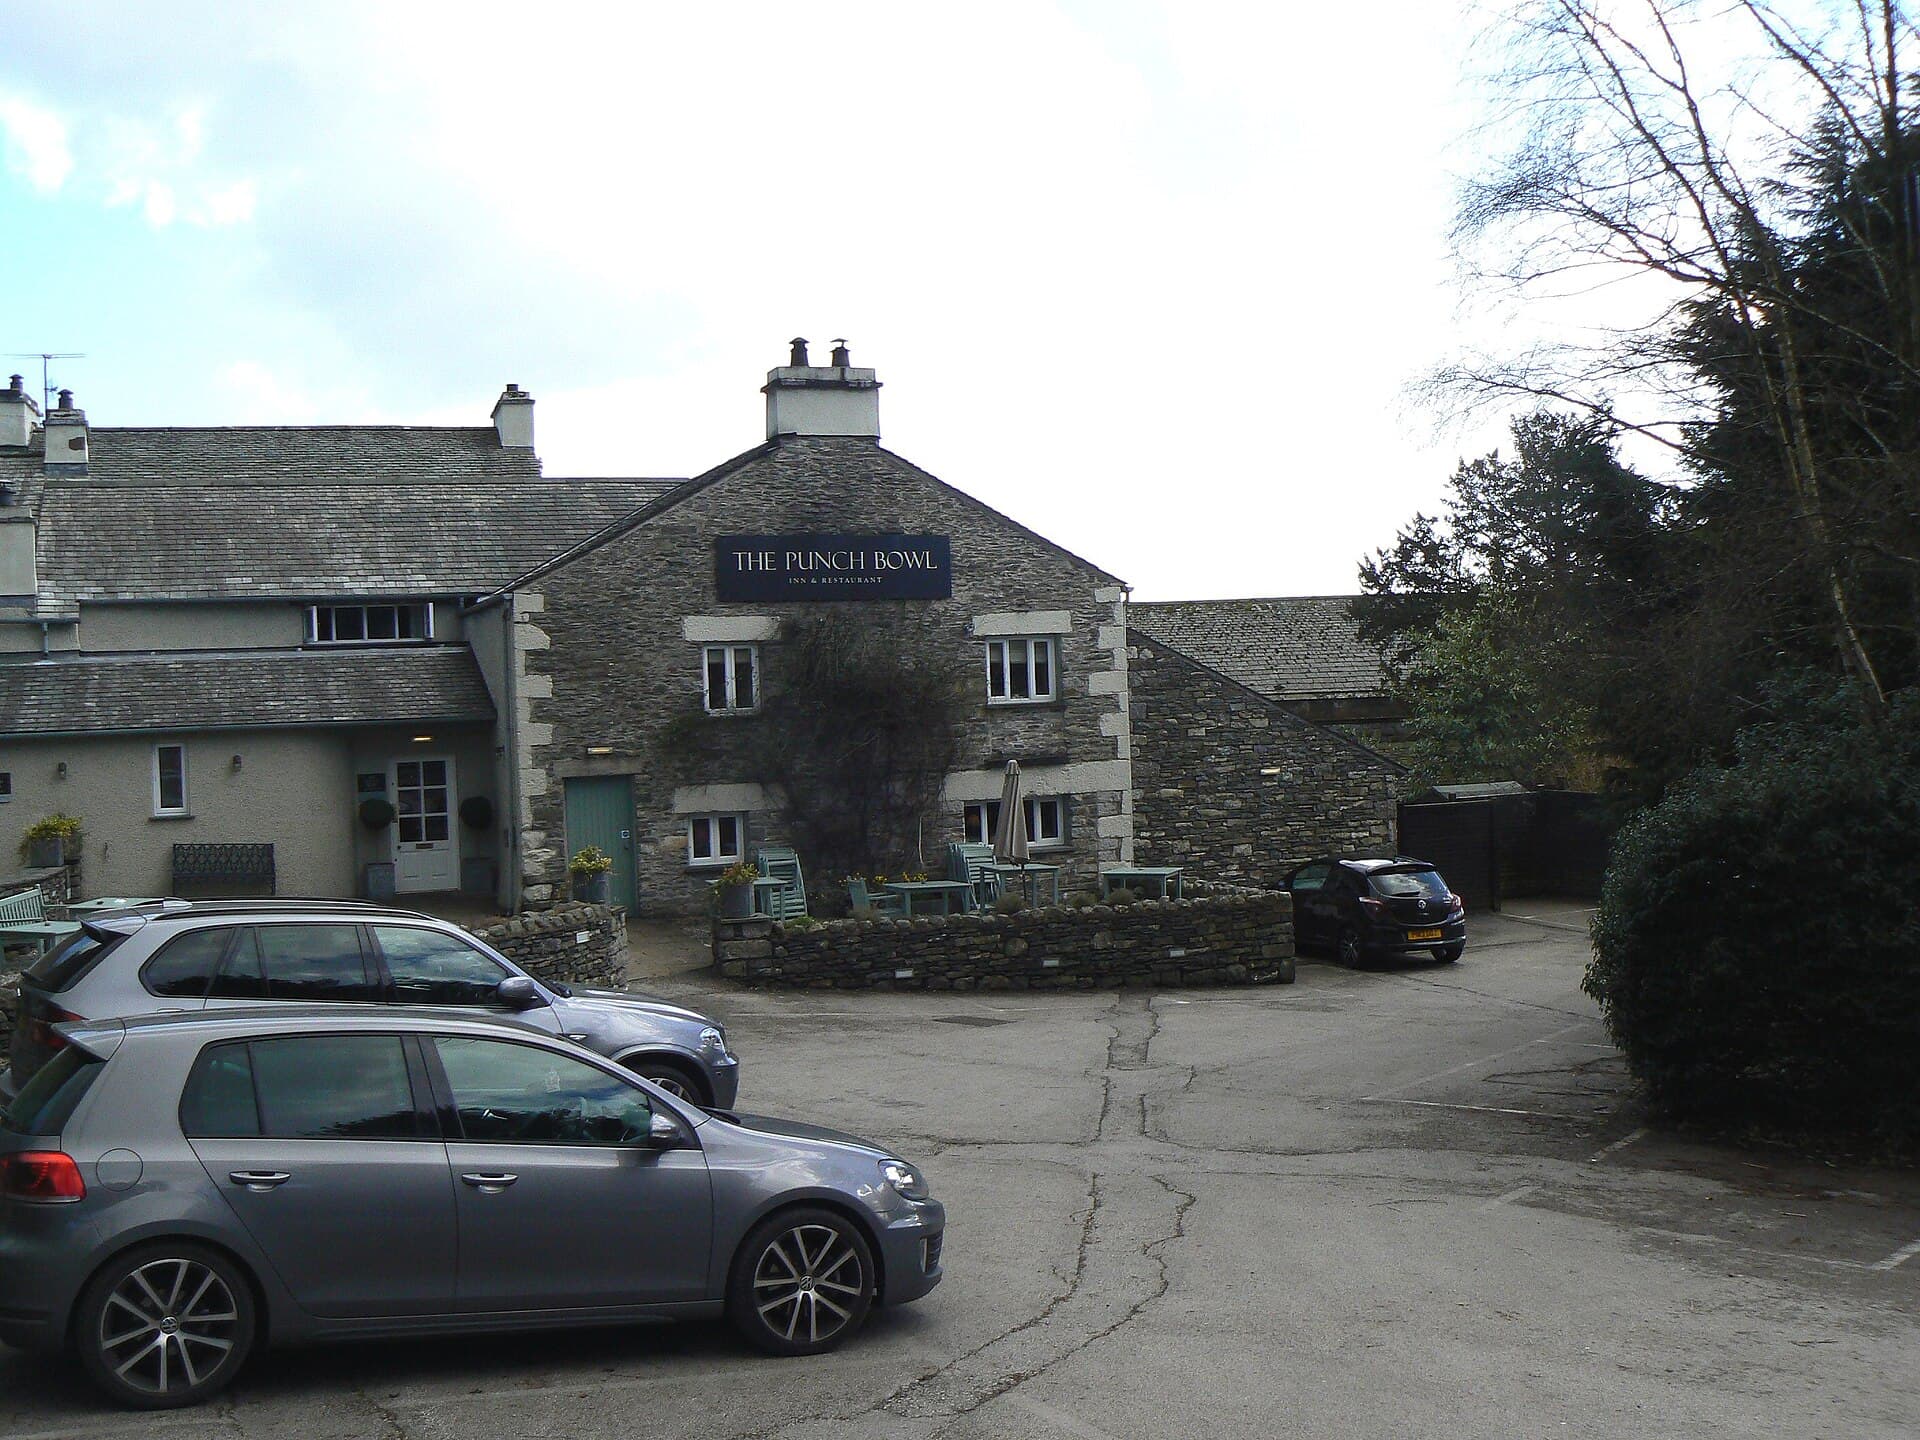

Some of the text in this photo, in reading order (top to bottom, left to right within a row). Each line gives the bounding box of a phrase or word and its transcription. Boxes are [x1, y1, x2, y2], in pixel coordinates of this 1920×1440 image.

[732, 551, 938, 571] THE PUNCH BOWL
[821, 576, 883, 584] RESTAURANT
